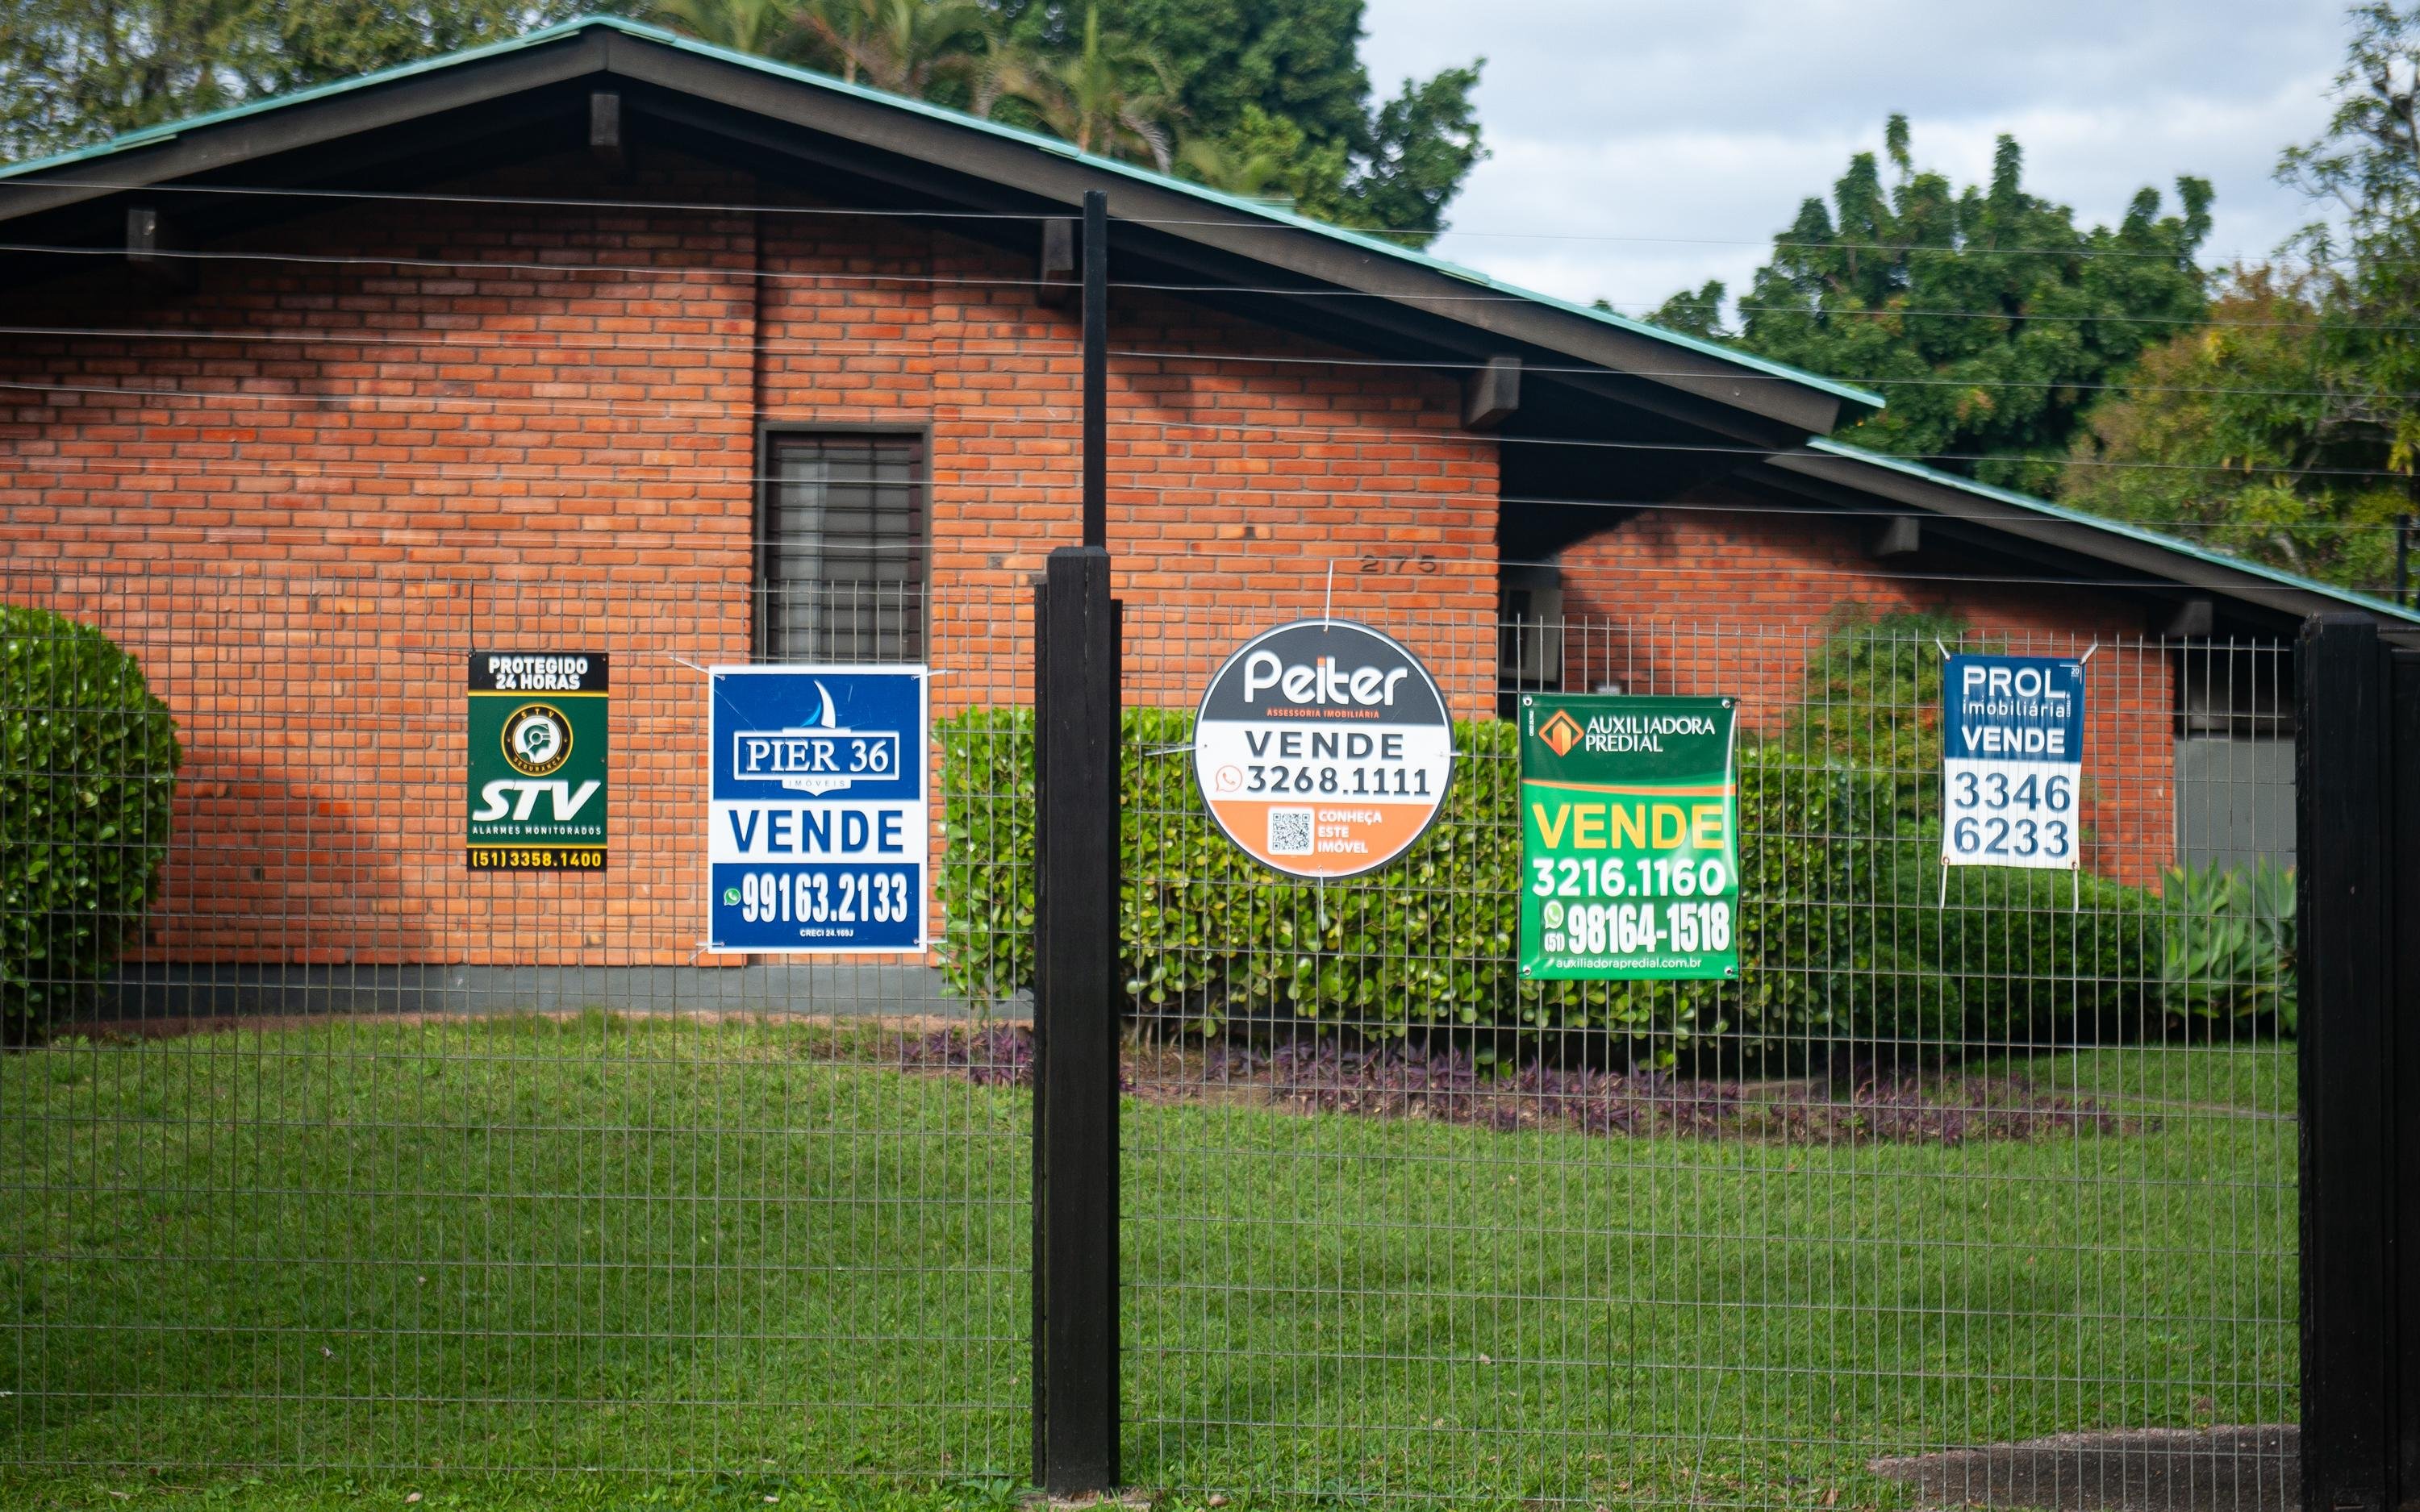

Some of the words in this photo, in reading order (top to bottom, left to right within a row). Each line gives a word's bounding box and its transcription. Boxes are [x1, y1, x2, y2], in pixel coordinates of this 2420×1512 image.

[1360, 555, 1436, 573] 275
[488, 656, 588, 674] PROTEGIDO
[495, 674, 516, 689] 24
[521, 674, 580, 690] HORAS
[1244, 650, 1408, 706] Peiter
[1963, 664, 2067, 699] PROL
[1266, 708, 1321, 718] ASSESSORIA
[1323, 708, 1379, 719] IMOBILIÁRIA
[1963, 698, 2066, 718] imobiliária
[1586, 715, 1716, 735] AUXILIADORA
[1245, 731, 1404, 761] VENDE
[1585, 735, 1663, 753] PREDIAL
[1961, 725, 2066, 754] VENDE
[746, 740, 840, 772] PIER
[849, 740, 889, 772] 36
[789, 778, 845, 788] IMÓVEIS
[1247, 765, 1431, 797] 3268.1111
[1954, 771, 2071, 814] 3346
[472, 781, 602, 822] STV
[1318, 809, 1383, 826] CONHEÇA
[1532, 803, 1725, 850] VENDE
[472, 825, 520, 835] ALARMES
[525, 825, 602, 835] MONITORADOS
[728, 810, 903, 853] VENDE
[1318, 826, 1350, 839] ESTE
[1954, 816, 2069, 859] 6233
[1317, 838, 1369, 854] IMÓVEL
[1532, 857, 1726, 898] 3216.1160
[742, 872, 908, 923] 99163.2133
[799, 928, 824, 937] CRECI
[1544, 931, 1565, 952] (51)
[1568, 901, 1730, 955] 98164-1518
[1555, 957, 1702, 970] auxiliadorapredial.com.br
